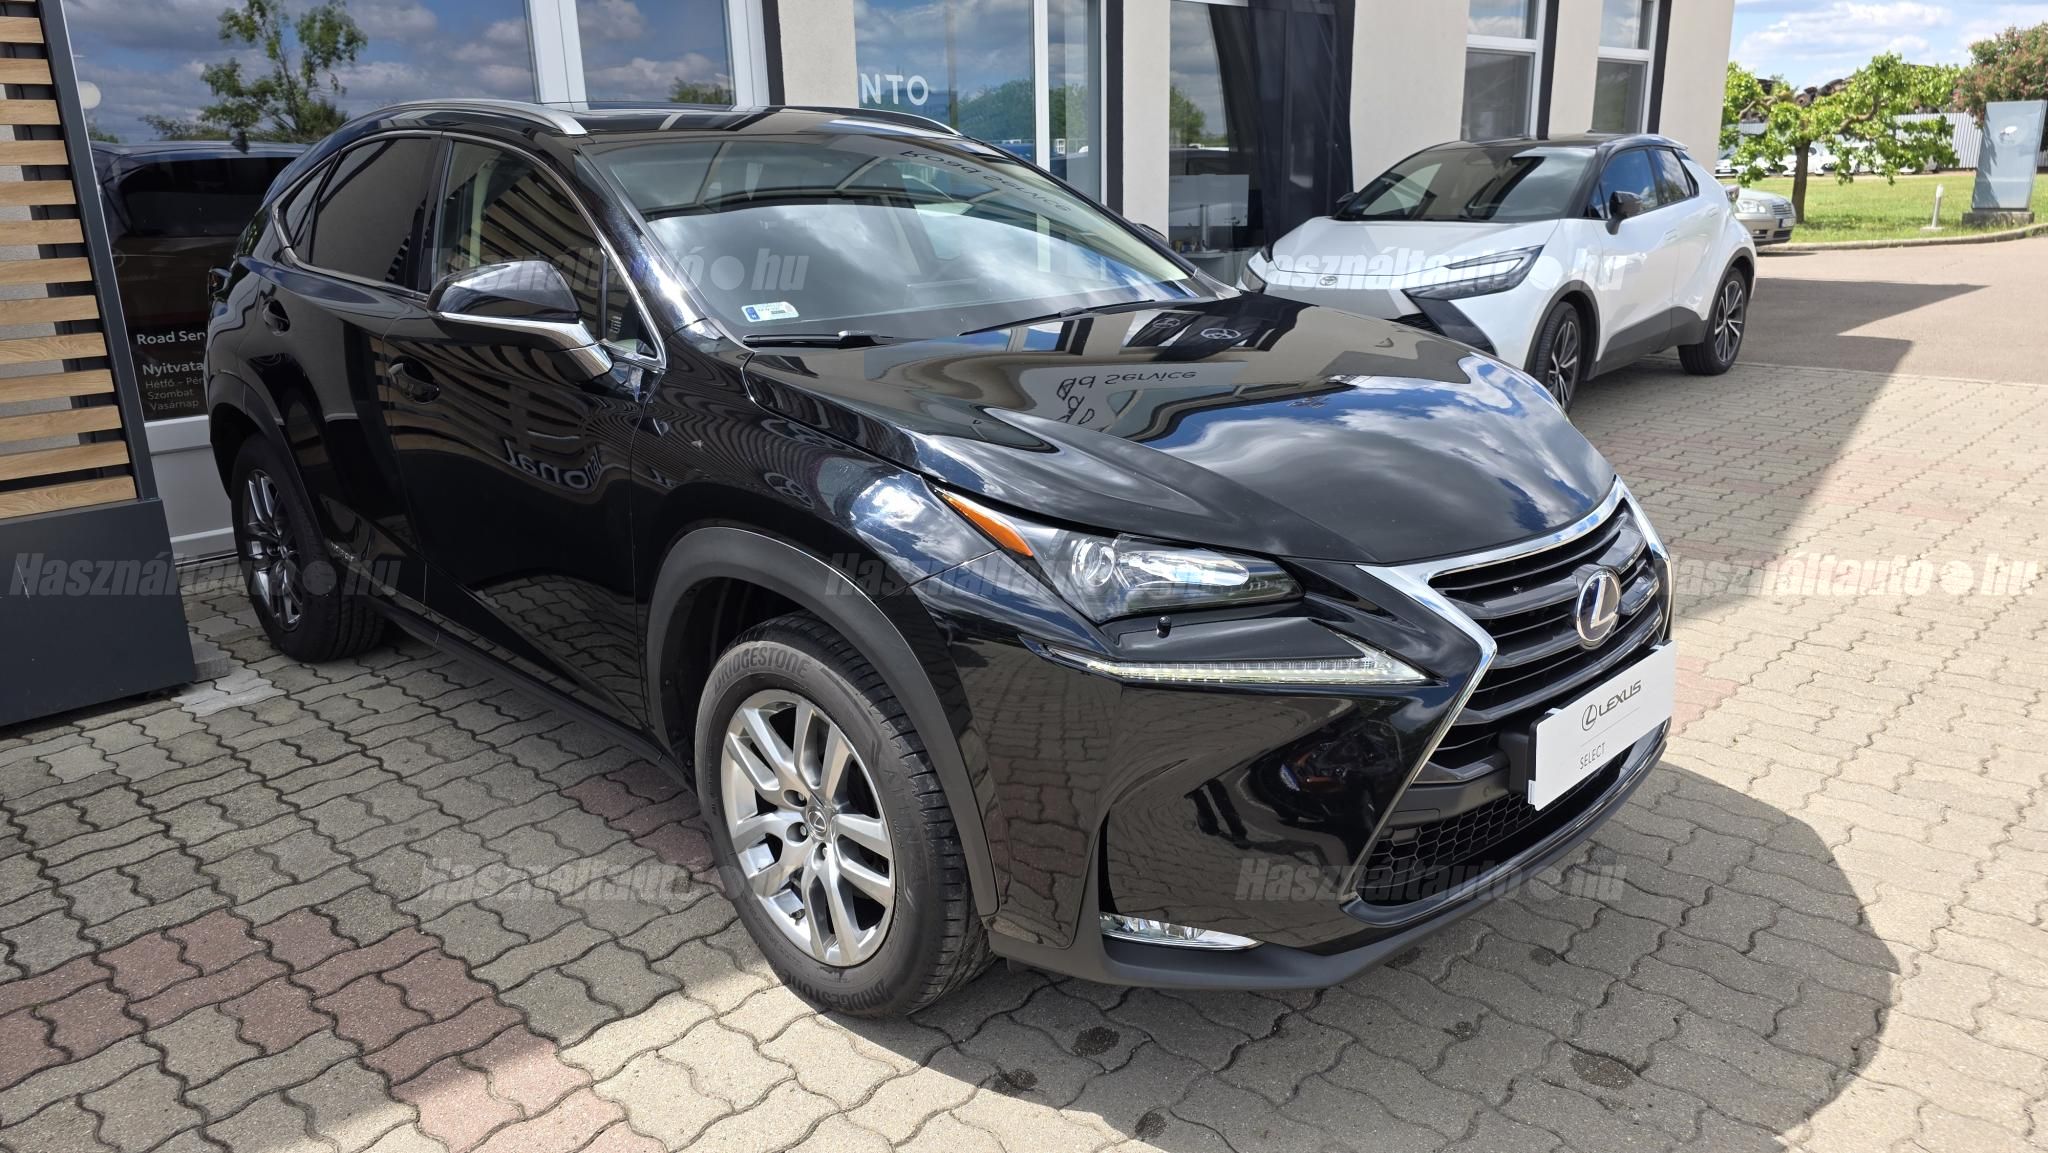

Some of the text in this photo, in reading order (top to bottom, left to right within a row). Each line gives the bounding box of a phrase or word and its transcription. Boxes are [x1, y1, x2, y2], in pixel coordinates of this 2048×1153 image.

[860, 73, 929, 106] NTO
[136, 330, 176, 345] Road
[147, 389, 194, 400] Szombat
[1599, 679, 1642, 717] LEXUS
[1579, 742, 1606, 770] SELECT
